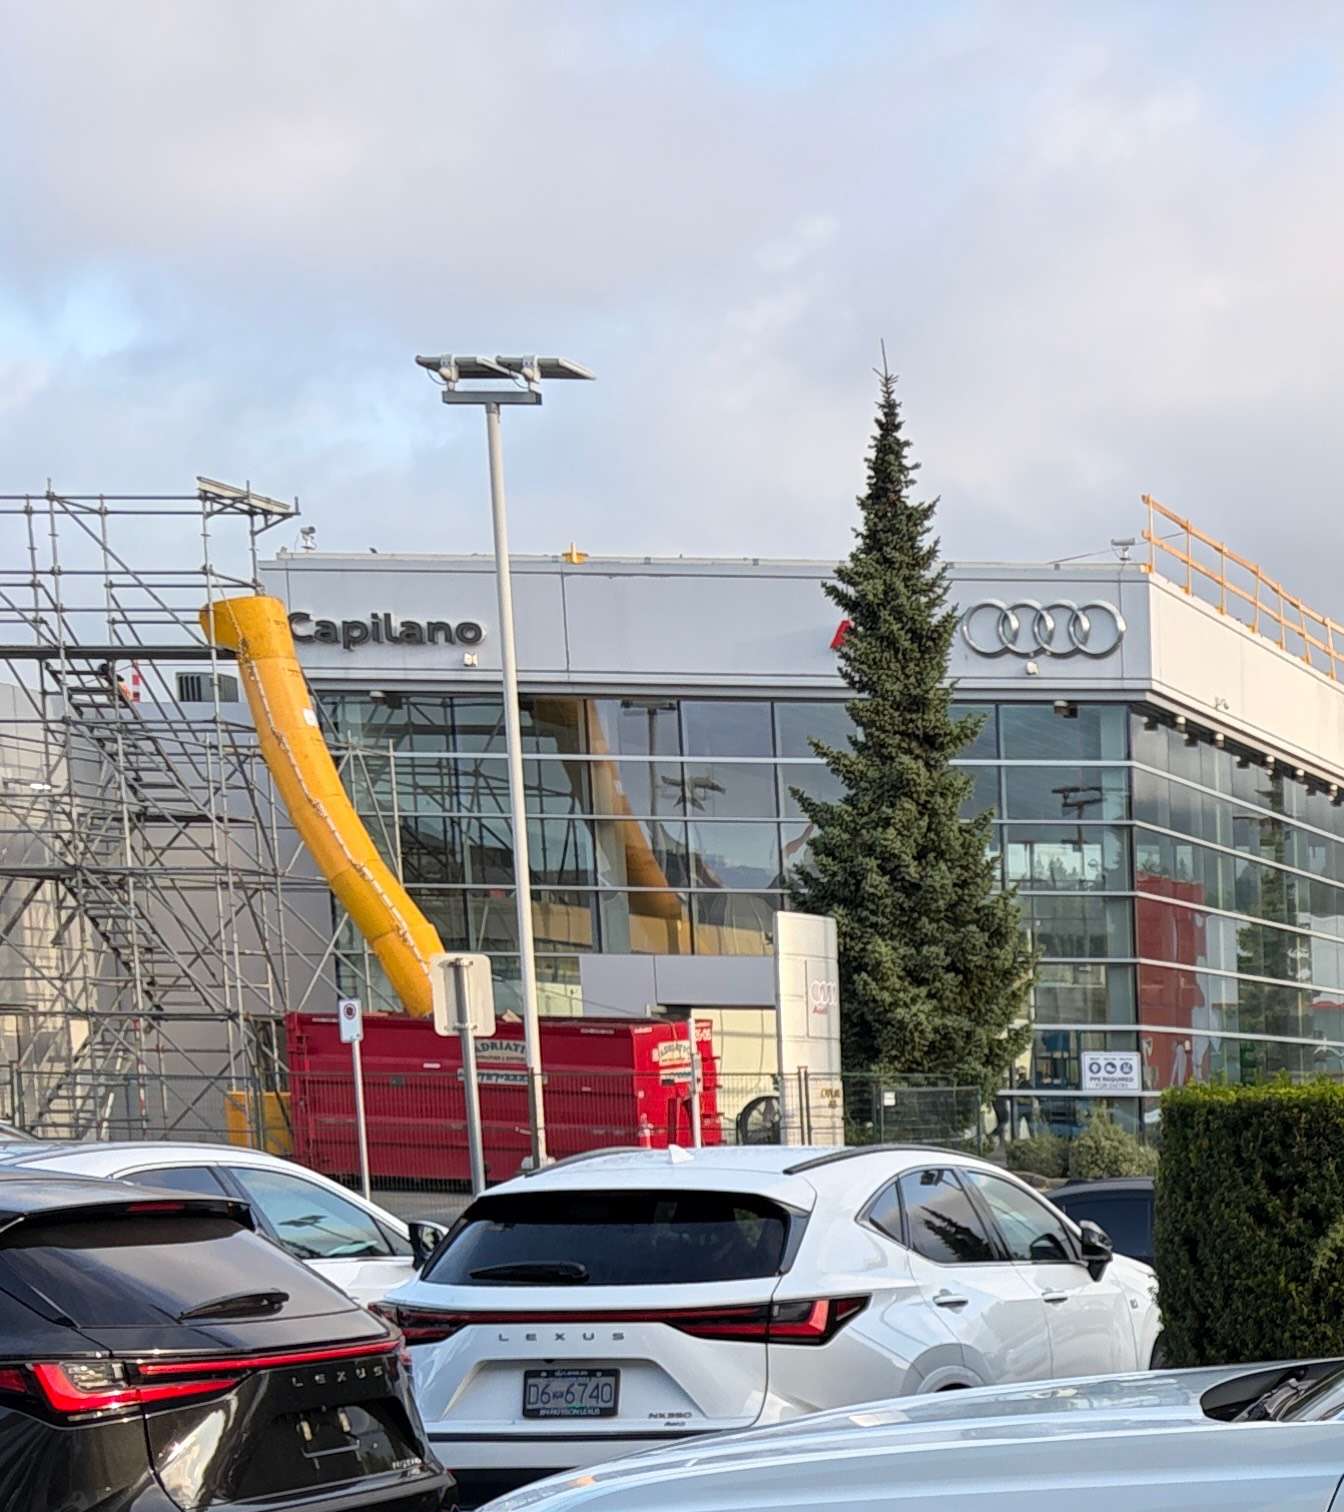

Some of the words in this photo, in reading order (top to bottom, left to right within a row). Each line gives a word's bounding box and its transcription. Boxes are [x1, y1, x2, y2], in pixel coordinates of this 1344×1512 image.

[288, 611, 483, 651] Capilano
[498, 1332, 625, 1342] LEXUS
[291, 1365, 384, 1388] LEXUS
